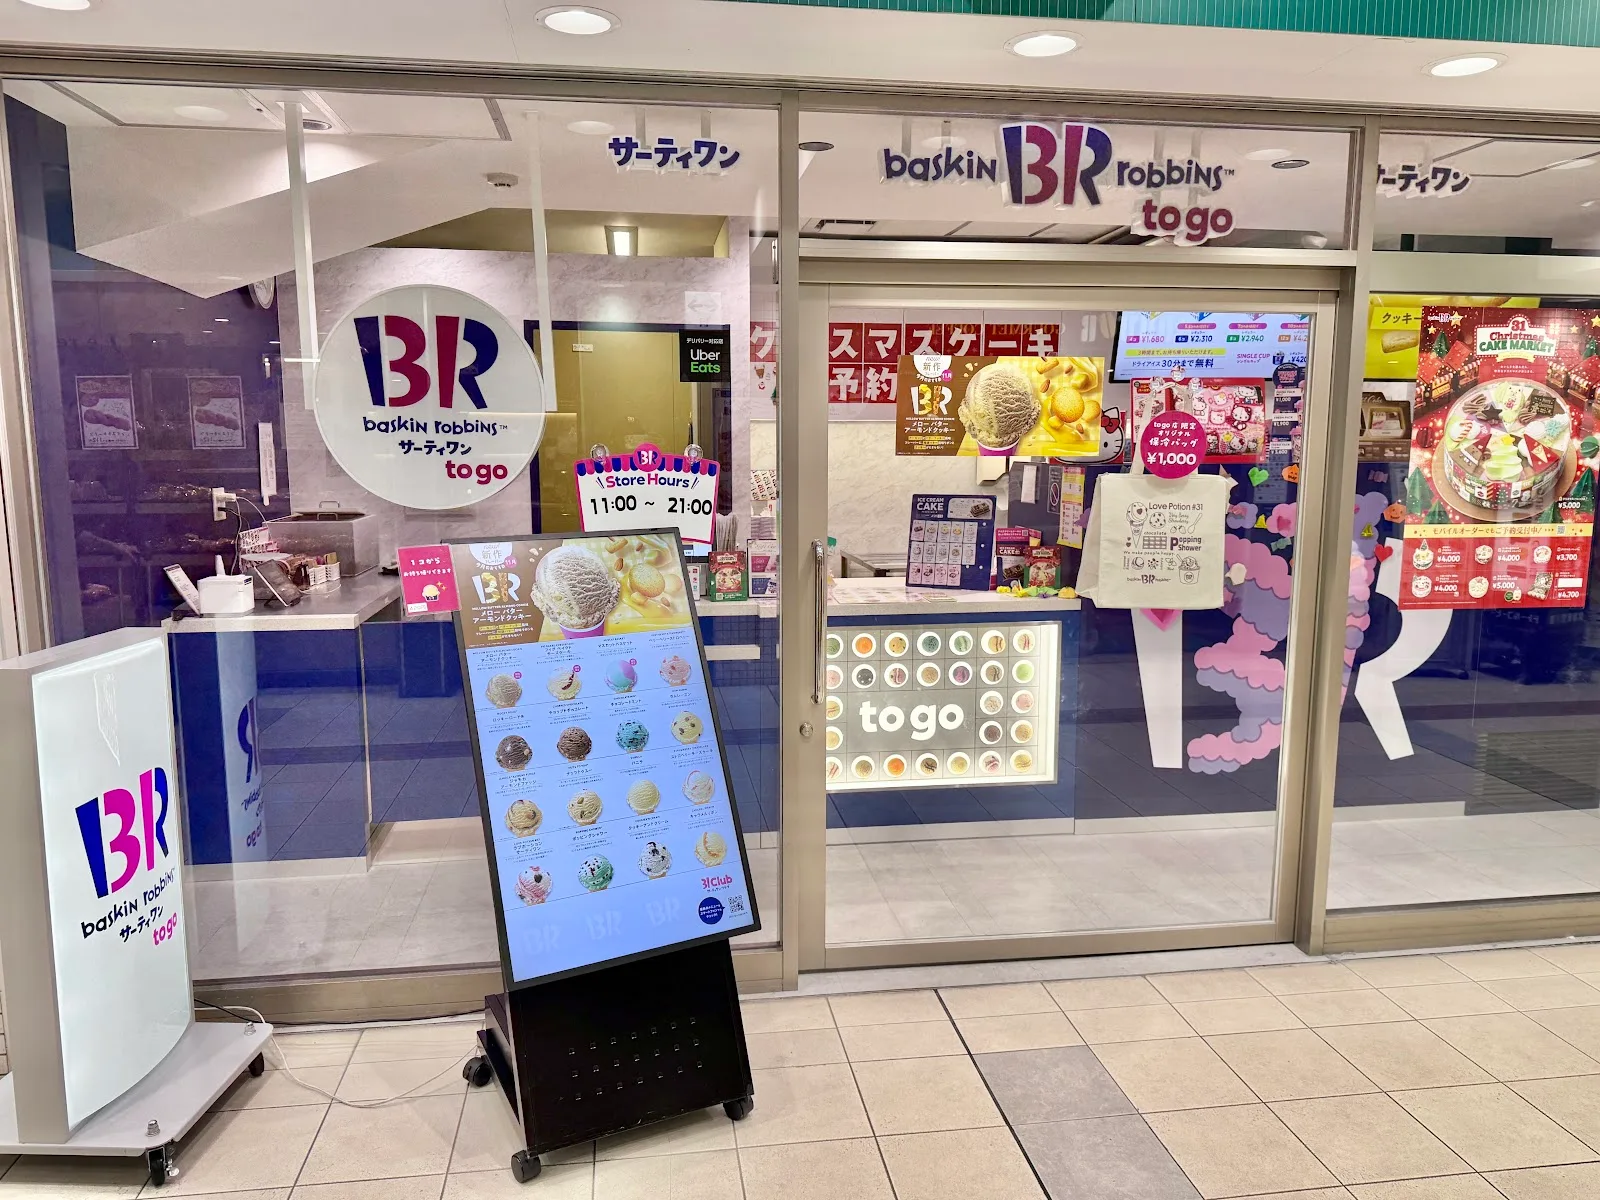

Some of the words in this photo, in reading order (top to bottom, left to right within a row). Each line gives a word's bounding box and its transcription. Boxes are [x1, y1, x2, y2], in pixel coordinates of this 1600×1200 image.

[608, 136, 740, 169] サーティワン
[883, 147, 997, 182] baskin
[1002, 124, 1112, 206] BR
[1381, 312, 1422, 325] クッキー
[1511, 319, 1527, 332] 31
[749, 324, 1055, 360] クスマスケーキ
[1489, 331, 1545, 341] Christmas
[690, 348, 721, 361] Uber
[1479, 340, 1508, 352] CAKE
[1509, 340, 1555, 353] MARKET
[353, 314, 499, 410] BR
[690, 361, 721, 374] Eats
[829, 365, 898, 401] 予約
[910, 383, 953, 416] BR
[362, 415, 428, 434] baskin
[398, 439, 472, 456] サーティワン
[1148, 437, 1199, 448] 保冷バッグ
[638, 450, 657, 466] BR
[1146, 452, 1197, 466] ¥1,000
[605, 474, 646, 488] Store
[646, 473, 690, 488] Hours
[590, 494, 637, 515] 11:00
[667, 497, 713, 516] 21:00
[916, 502, 945, 511] CAKE
[1148, 502, 1168, 510] Love
[1168, 502, 1191, 511] Potion
[1191, 503, 1203, 511] #31
[1141, 574, 1156, 585] BR
[471, 572, 521, 605] BR
[472, 613, 532, 624] アーモンドクッキー
[480, 609, 501, 618] メロー
[502, 606, 523, 615] バター
[858, 700, 905, 733] to
[909, 703, 965, 741] go
[74, 766, 169, 899] BR
[80, 898, 139, 940] baskin
[119, 905, 164, 943] サーティワン
